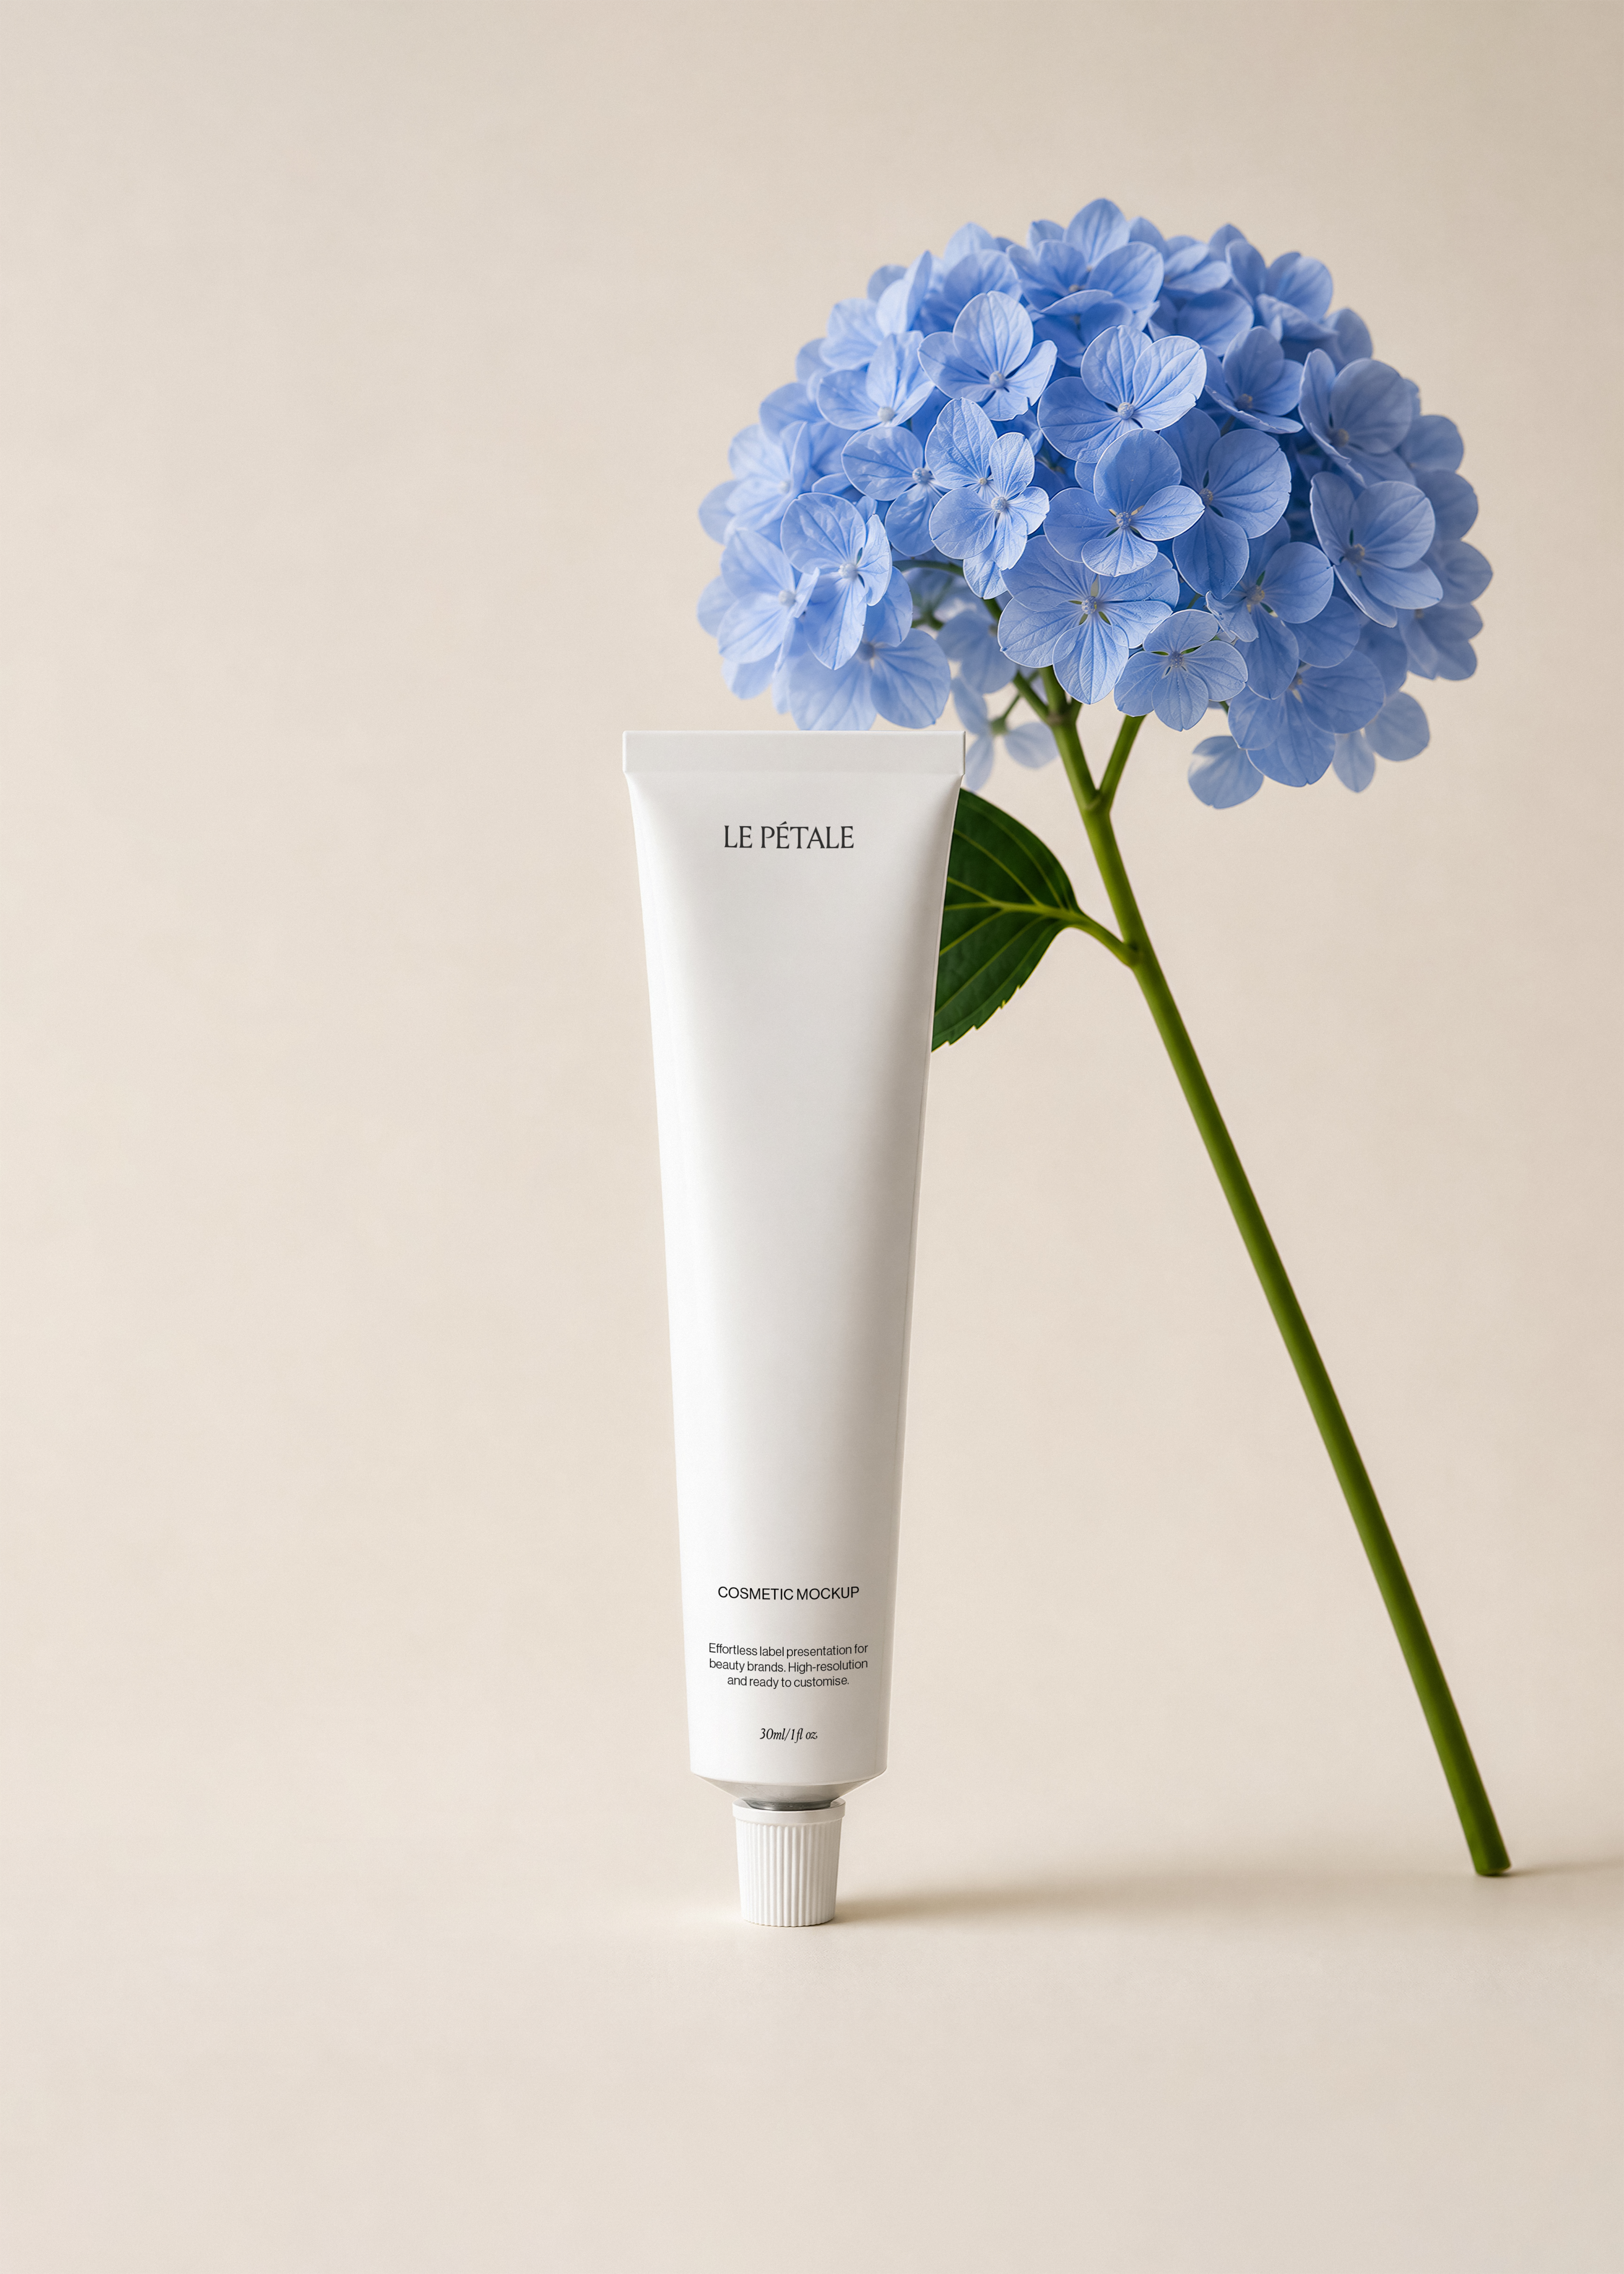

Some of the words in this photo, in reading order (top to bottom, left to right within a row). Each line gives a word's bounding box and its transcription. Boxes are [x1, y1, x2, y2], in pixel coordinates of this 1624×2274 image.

[724, 825, 753, 849] LE
[761, 821, 854, 849] PÉTALE
[718, 1586, 794, 1601] COSMETIC
[796, 1586, 860, 1601] MOCKUP
[709, 1642, 758, 1656] Effortless
[759, 1646, 784, 1657] label
[787, 1645, 852, 1659] presentation
[854, 1643, 869, 1654] for
[709, 1657, 745, 1673] beauty
[747, 1661, 786, 1673] brands.
[788, 1659, 868, 1675] High-resolution
[727, 1675, 747, 1686] and
[749, 1676, 779, 1689] ready
[781, 1677, 792, 1688] to
[794, 1675, 849, 1687] customise.
[805, 1731, 818, 1740] oz
